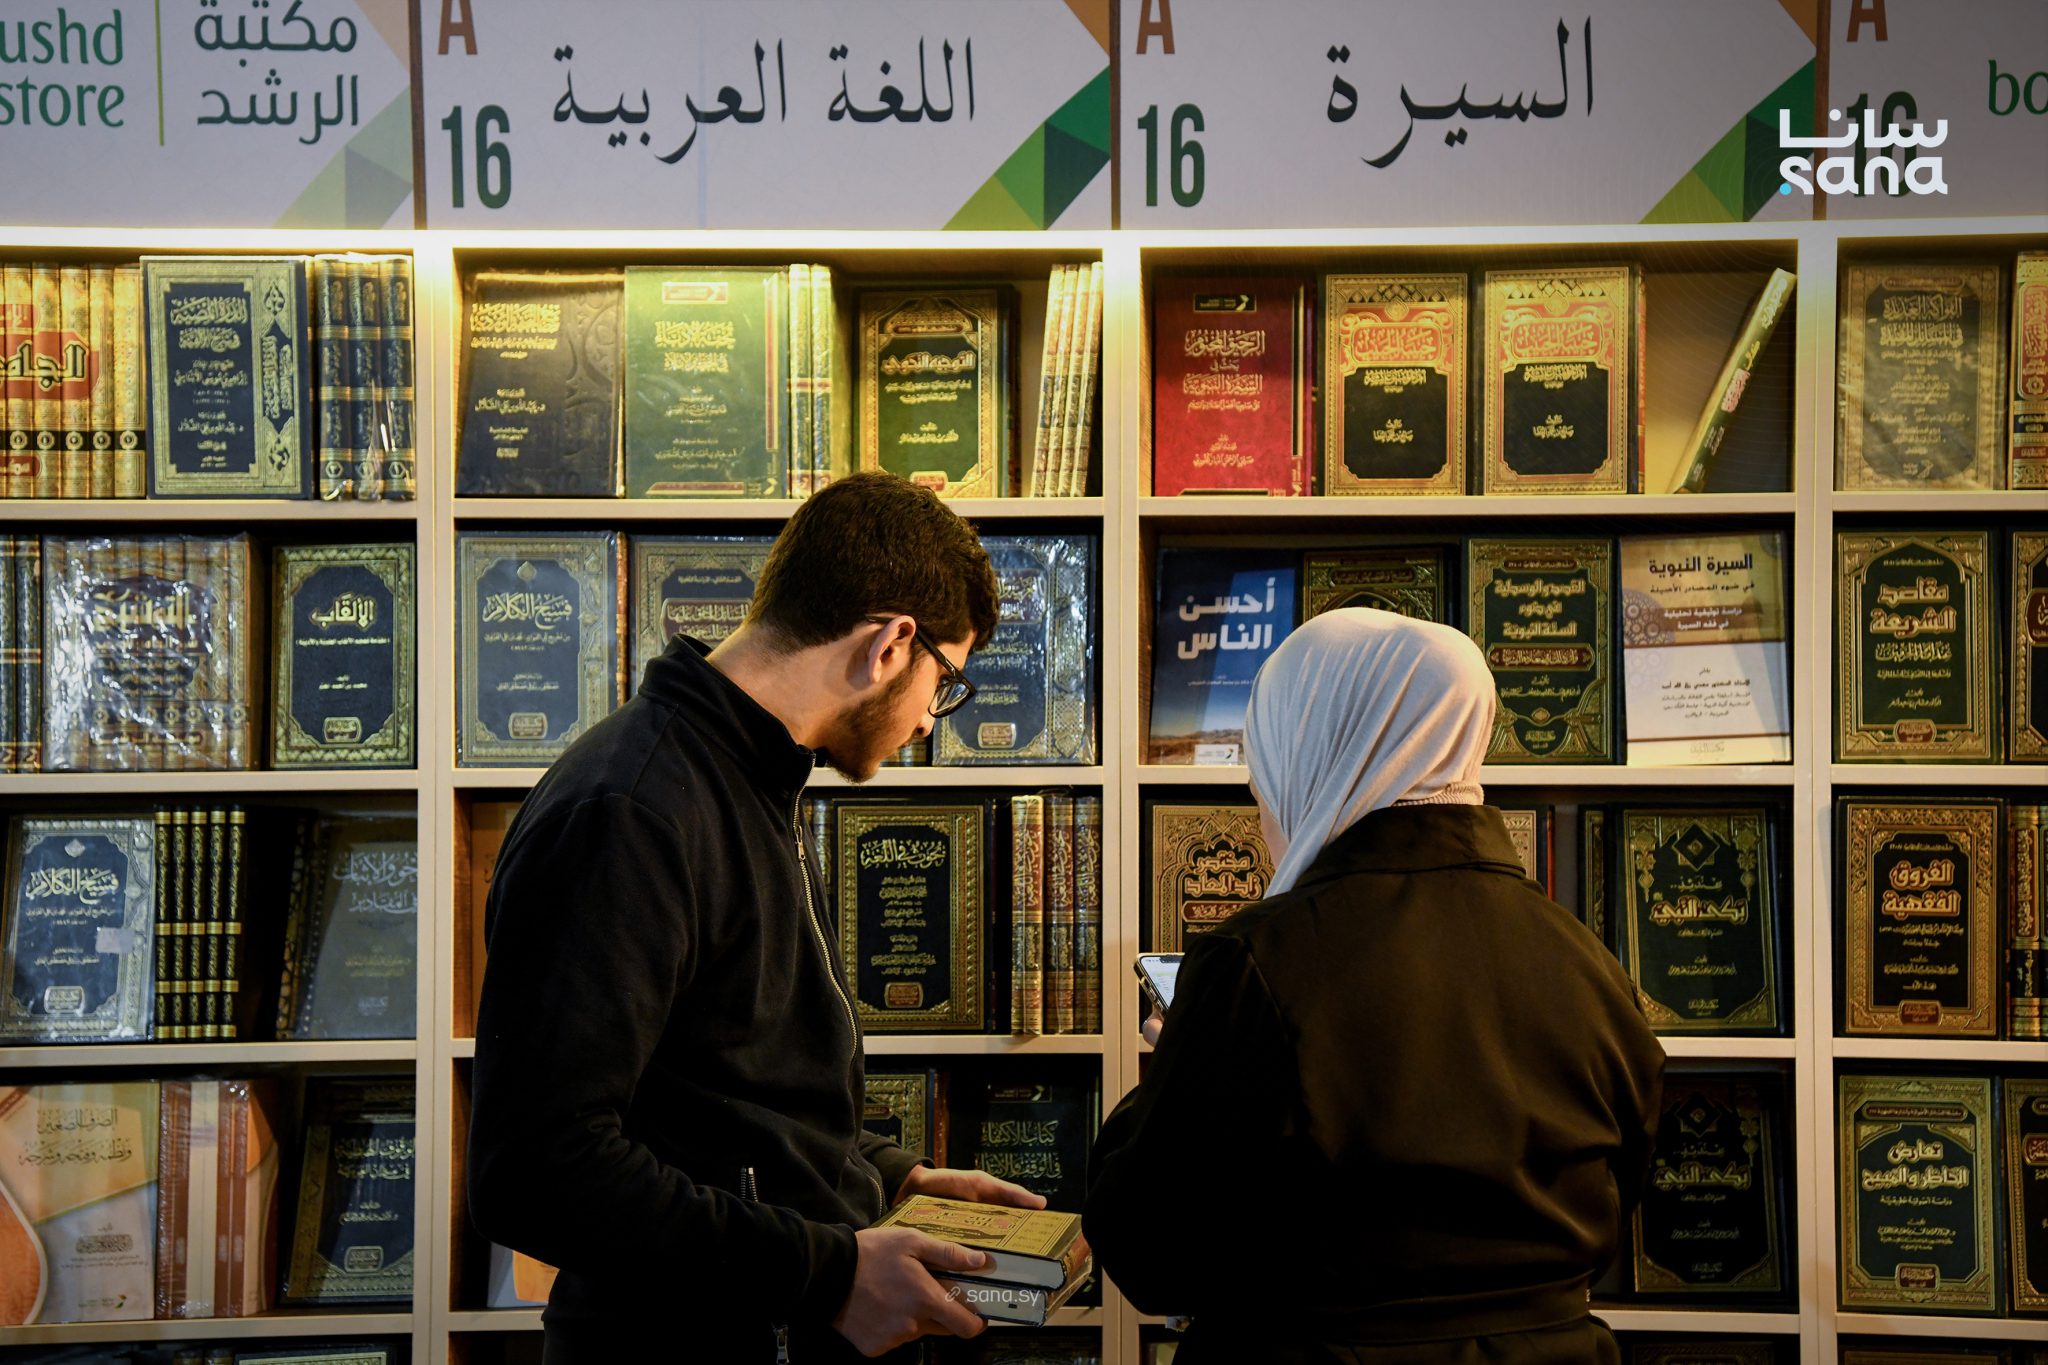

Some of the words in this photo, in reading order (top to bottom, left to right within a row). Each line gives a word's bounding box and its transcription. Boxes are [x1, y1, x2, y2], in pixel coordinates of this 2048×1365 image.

[195, 0, 358, 68] مكتبة
[828, 36, 974, 123] اللغة
[1326, 15, 1592, 169] السيرة
[196, 70, 359, 145] الرشد
[553, 38, 786, 165] العربية
[441, 105, 512, 209] 16
[1137, 103, 1205, 207] 16
[1223, 330, 1265, 356] الرحيق
[927, 352, 975, 372] التوجيه
[1649, 556, 1701, 578] النبوية
[1706, 553, 1753, 575] السيرة
[1178, 577, 1276, 621] أحسن
[1684, 584, 1718, 593] المصادر
[1720, 582, 1739, 591] ضوء
[1742, 580, 1755, 593] في
[1878, 577, 1949, 607] مقاصد
[311, 593, 374, 628] الألقاب
[1677, 620, 1702, 630] السيرة
[1718, 619, 1729, 631] في
[1870, 607, 1957, 638] الشريعة
[1177, 624, 1273, 660] الناس
[860, 838, 899, 869] اللغة
[1194, 851, 1250, 873] مختصر
[1185, 872, 1234, 897] المعاد
[1235, 873, 1261, 899] زاد
[1889, 859, 1955, 891] الفروق
[1650, 896, 1700, 926] النبي
[1698, 895, 1748, 924] بكى
[1882, 890, 1961, 920] الفقهية
[37, 1108, 82, 1134] الصغير
[79, 1108, 118, 1130] الصرف
[1021, 1120, 1059, 1147] كتاب
[1887, 1139, 1944, 1165] تعارض
